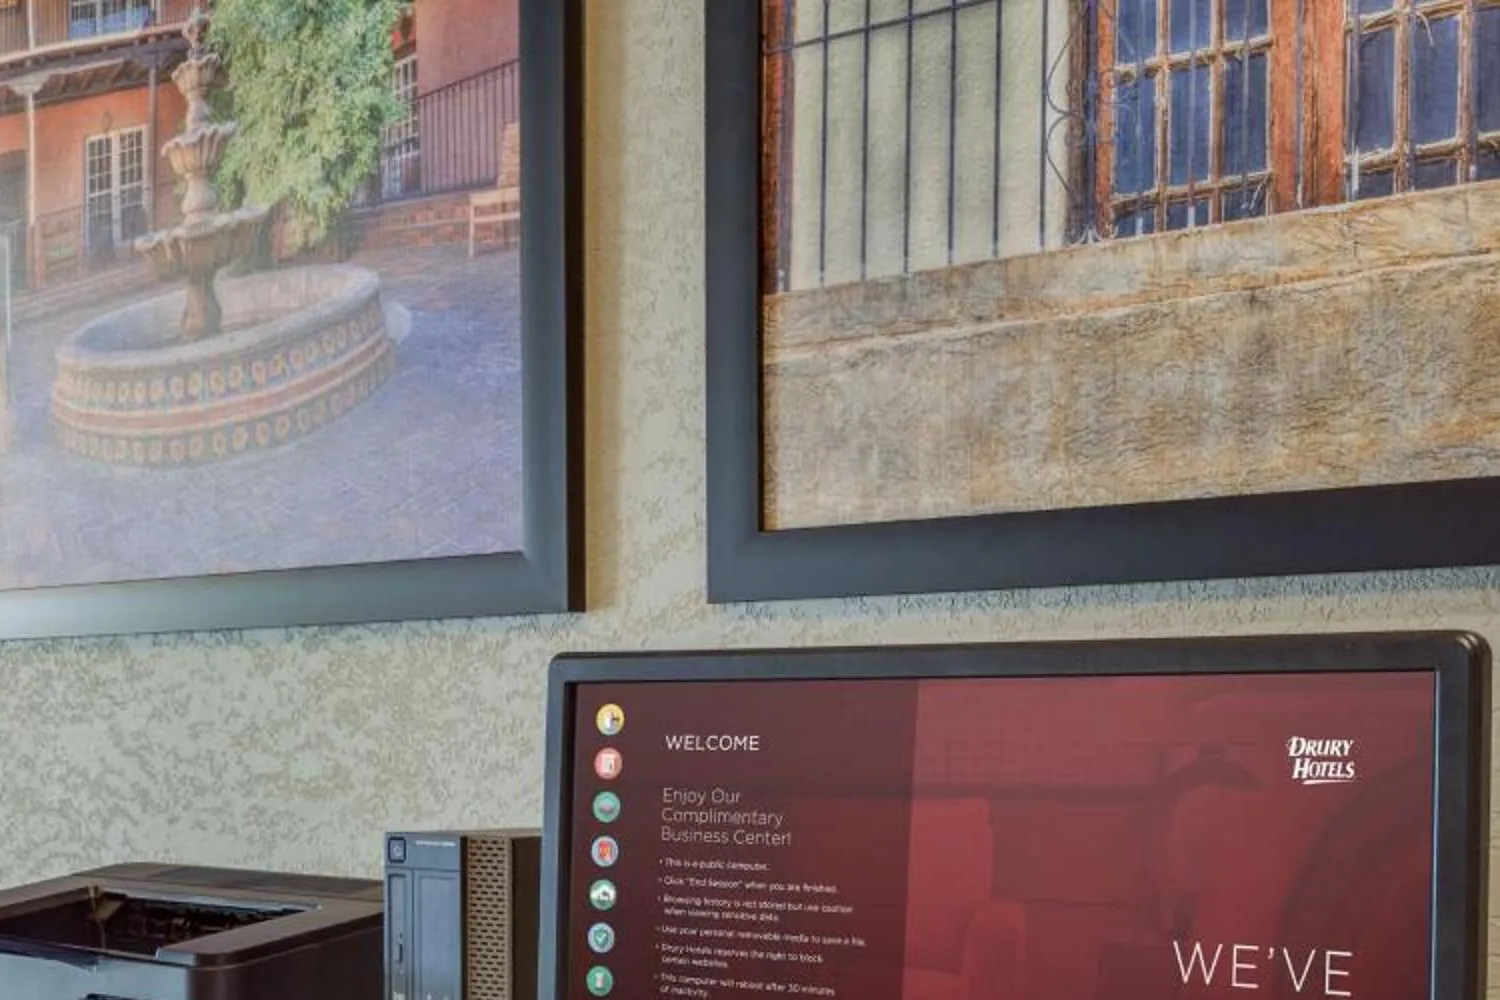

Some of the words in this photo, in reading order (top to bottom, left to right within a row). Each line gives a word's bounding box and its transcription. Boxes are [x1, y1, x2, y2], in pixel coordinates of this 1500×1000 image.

[664, 734, 761, 752] WELCOME
[1285, 735, 1356, 757] DRURY
[1292, 757, 1356, 779] HOTELS
[662, 786, 706, 807] Enjoy
[711, 786, 742, 804] Our
[660, 806, 784, 830] Complimentary
[660, 825, 730, 844] Business
[1172, 939, 1354, 998] WE'VE
